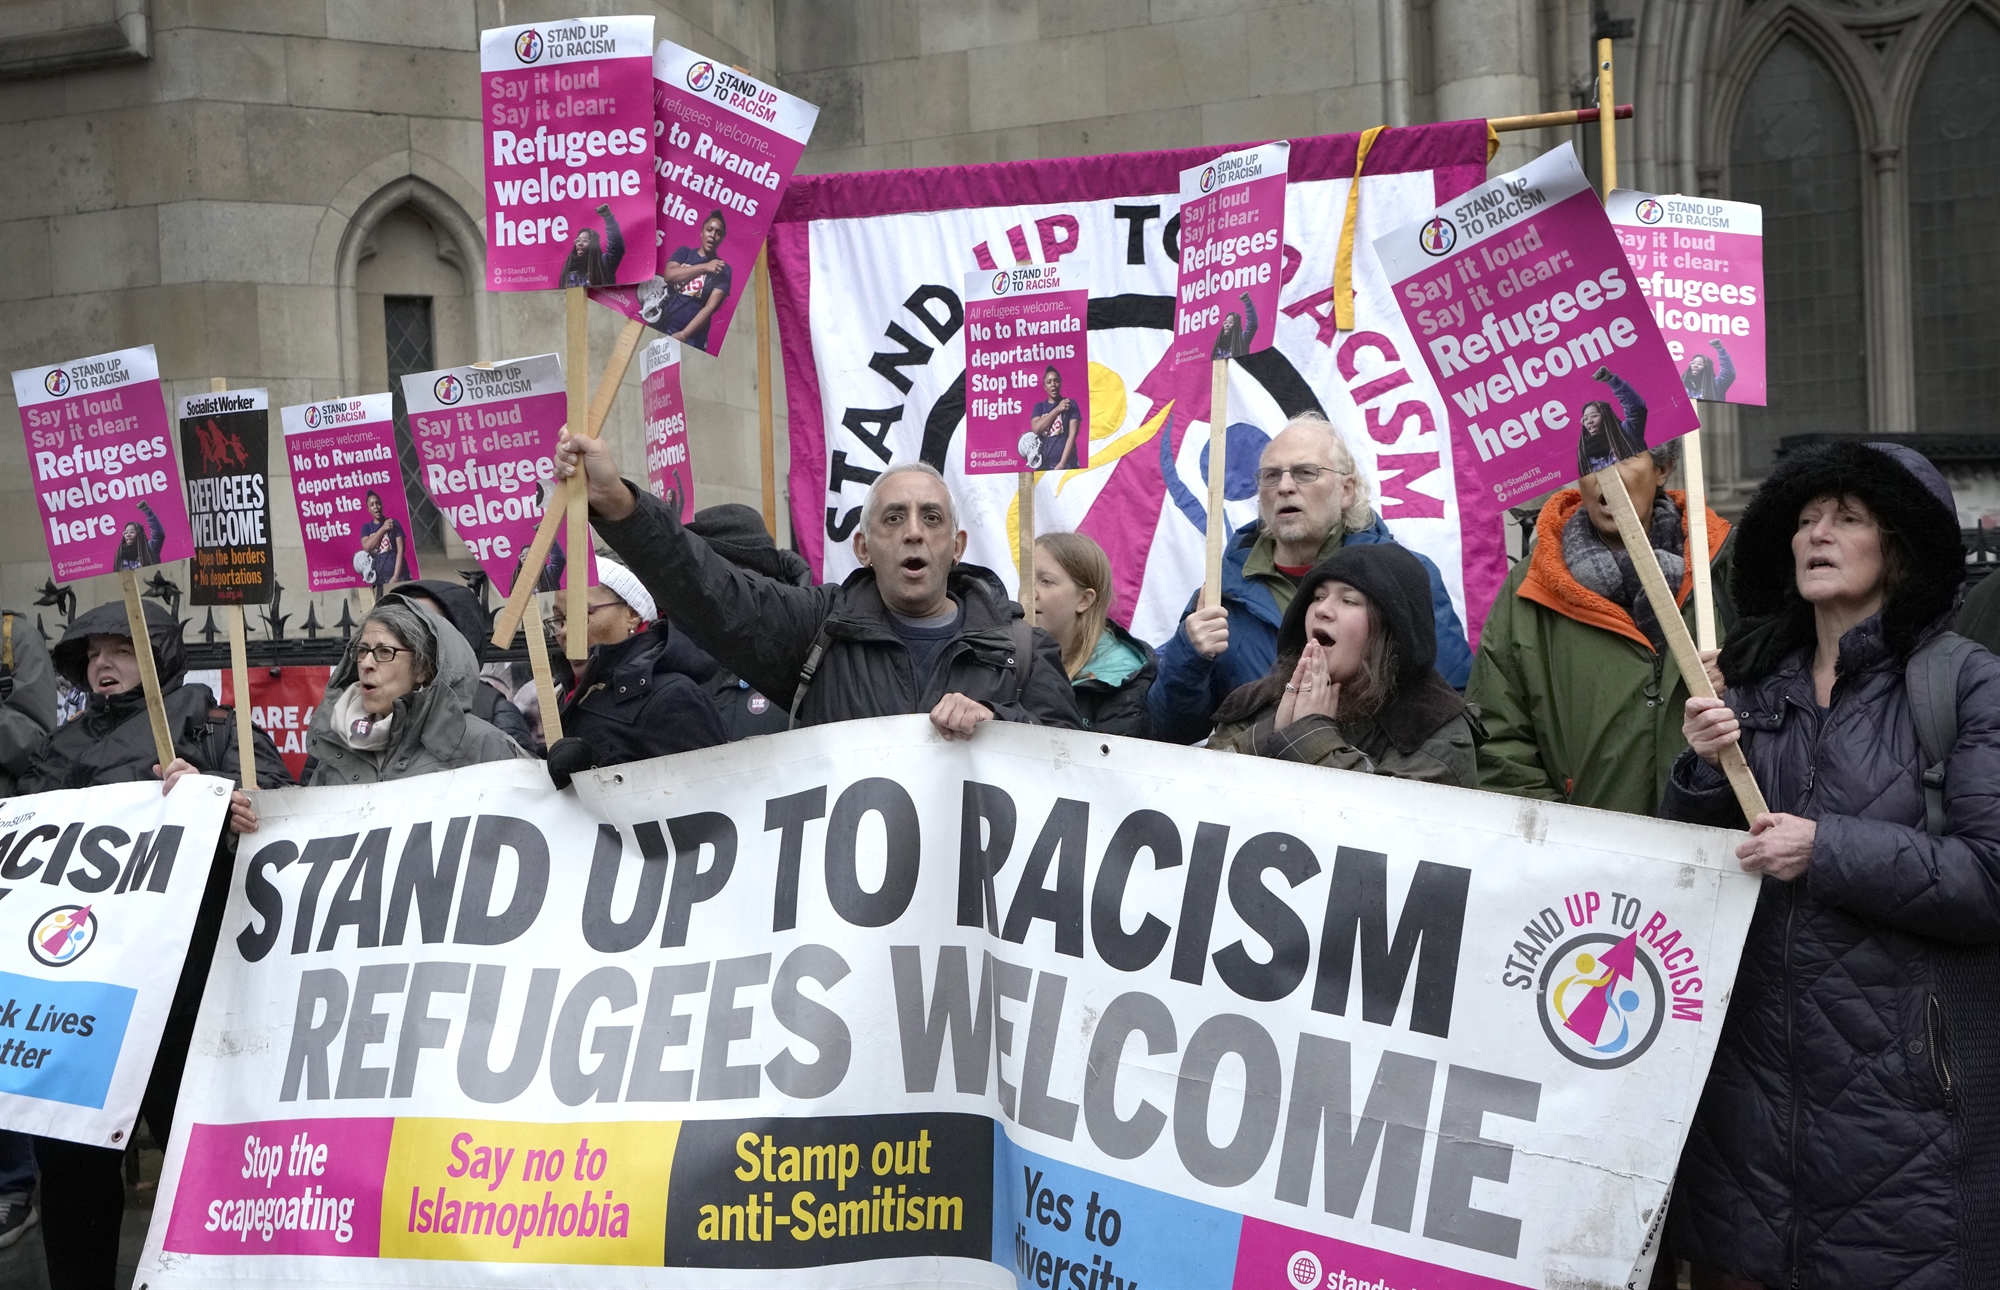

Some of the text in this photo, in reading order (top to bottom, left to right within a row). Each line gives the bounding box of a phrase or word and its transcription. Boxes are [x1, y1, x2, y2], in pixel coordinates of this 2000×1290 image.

[547, 24, 608, 43] STAND UP
[548, 39, 615, 58] TO RACISM
[491, 66, 599, 102] Say it loud
[718, 71, 777, 106] STAND UP
[492, 95, 616, 128] Say it clear:
[713, 85, 776, 123] TO RACISM
[663, 97, 776, 157] refugees welcome...
[493, 126, 647, 168] Refugees
[669, 122, 780, 191] to Rwanda
[1218, 153, 1258, 173] STAND UP
[494, 167, 640, 206] welcome
[1218, 164, 1262, 184] TO RACISM
[662, 192, 698, 226] the
[1184, 186, 1250, 224] Say it loud
[1454, 177, 1528, 224] STAND UP
[1461, 188, 1546, 240] TO RACISM
[1668, 201, 1723, 216] STAND UP
[495, 211, 569, 246] here
[1184, 208, 1260, 244] Say it clear:
[1669, 213, 1730, 228] TO RACISM
[1182, 228, 1278, 274] Refugees
[1614, 228, 1716, 251] Say it loud
[1012, 267, 1056, 281] STAND UP
[1404, 224, 1544, 308] Say it loud
[1653, 251, 1729, 273] it clear:
[1012, 278, 1060, 292] TO RACISM
[1180, 262, 1271, 304] welcome
[1416, 249, 1575, 335] Say it clear:
[1636, 270, 1756, 308] efugees
[970, 301, 1071, 320] All refugees welcome...
[970, 314, 1080, 342] No to Rwanda
[1178, 304, 1220, 336] here
[1428, 267, 1627, 379] Refugees
[72, 358, 121, 379] STAND UP
[971, 343, 1075, 370] deportations
[1451, 316, 1639, 419] welcome
[74, 369, 130, 391] TO RACISM
[465, 367, 521, 387] STAND UP
[468, 379, 532, 400] TO RACISM
[972, 370, 1038, 395] Stop the
[28, 393, 123, 429] Say it loud
[322, 401, 361, 415] STAND UP
[323, 410, 366, 425] TO RACISM
[417, 404, 522, 439] Say it loud
[826, 284, 964, 543] STAND
[972, 398, 1022, 420] flights
[31, 415, 139, 449] Say it clear:
[291, 431, 381, 452] All refugees welcome...
[422, 430, 540, 462] Say it clear:
[1467, 399, 1571, 463] here
[35, 436, 167, 481] Refugees
[293, 443, 392, 472] No to Rwanda
[42, 470, 168, 513] welcome
[189, 473, 264, 513] REFUGEES
[298, 470, 391, 496] deportations
[427, 458, 554, 495] Refugee
[1502, 466, 1542, 490] @StandUTR
[1505, 469, 1562, 499] @AntiRacismDay
[301, 495, 362, 519] Stop the
[49, 514, 117, 546] here
[191, 510, 267, 548] WELCOME
[305, 520, 352, 542] flights
[199, 547, 266, 569] Open the borders
[200, 568, 263, 589] No deportations
[236, 776, 1473, 1039] STAND UP TO RACISM
[1502, 892, 1704, 1022] STAND UP TO RACISM
[25, 1003, 96, 1038] Lives
[278, 943, 1542, 1260] REFUGEES WELCOME
[241, 1132, 328, 1183] Stop the
[446, 1130, 608, 1184] Say no to
[734, 1130, 931, 1191] Stamp out
[204, 1186, 355, 1244] scapegoating
[407, 1187, 630, 1249] Islamophobia
[696, 1181, 964, 1245] anti-Semitism
[1023, 1166, 1122, 1247] Yes to
